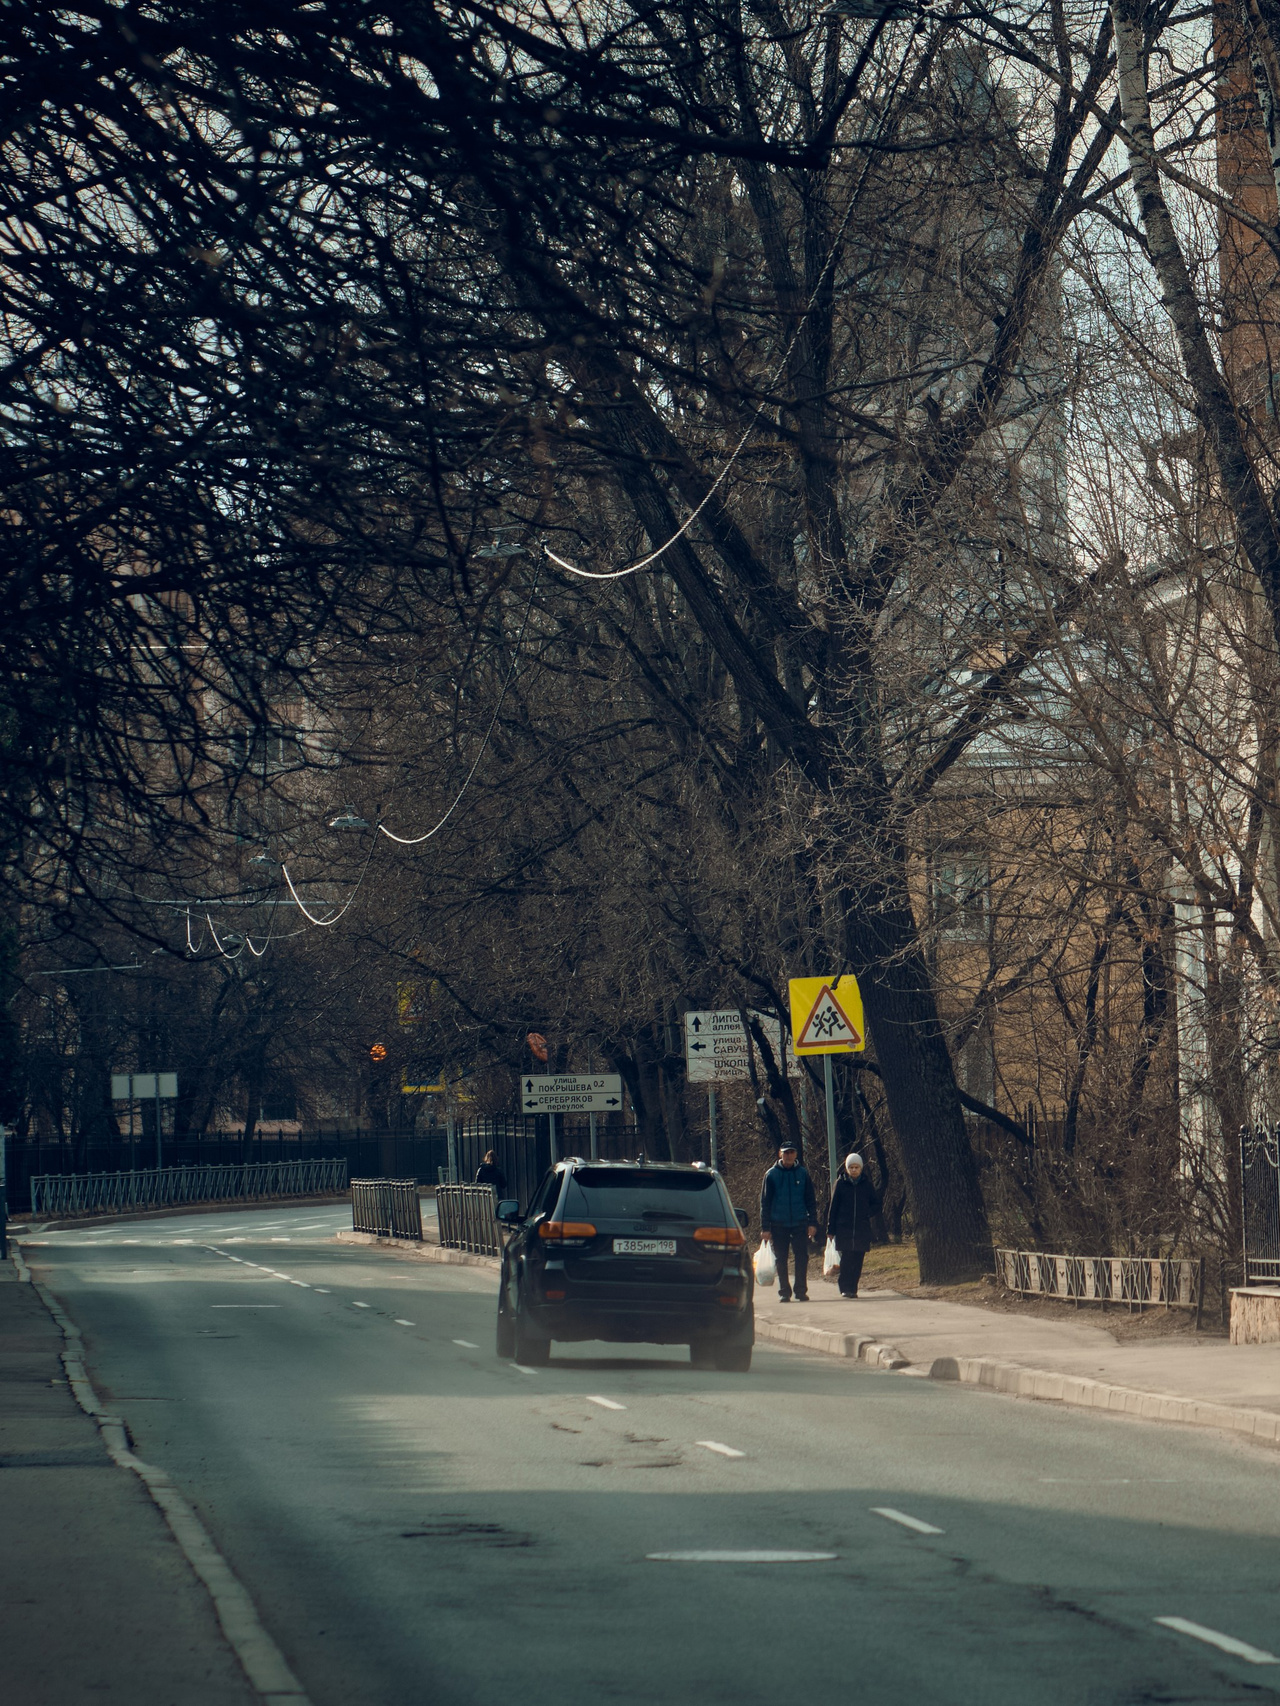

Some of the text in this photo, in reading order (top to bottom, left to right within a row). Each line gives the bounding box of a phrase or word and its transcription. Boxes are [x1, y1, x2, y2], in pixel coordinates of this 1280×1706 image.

[712, 1023, 741, 1031] аллея
[713, 1036, 742, 1046] улица
[553, 1077, 577, 1085] улица
[538, 1084, 592, 1093] ПОКРЫШЕВА
[538, 1095, 593, 1104] СЕРЕБРЯКОВ
[547, 1103, 585, 1112] переулок
[658, 1240, 674, 1249] 198
